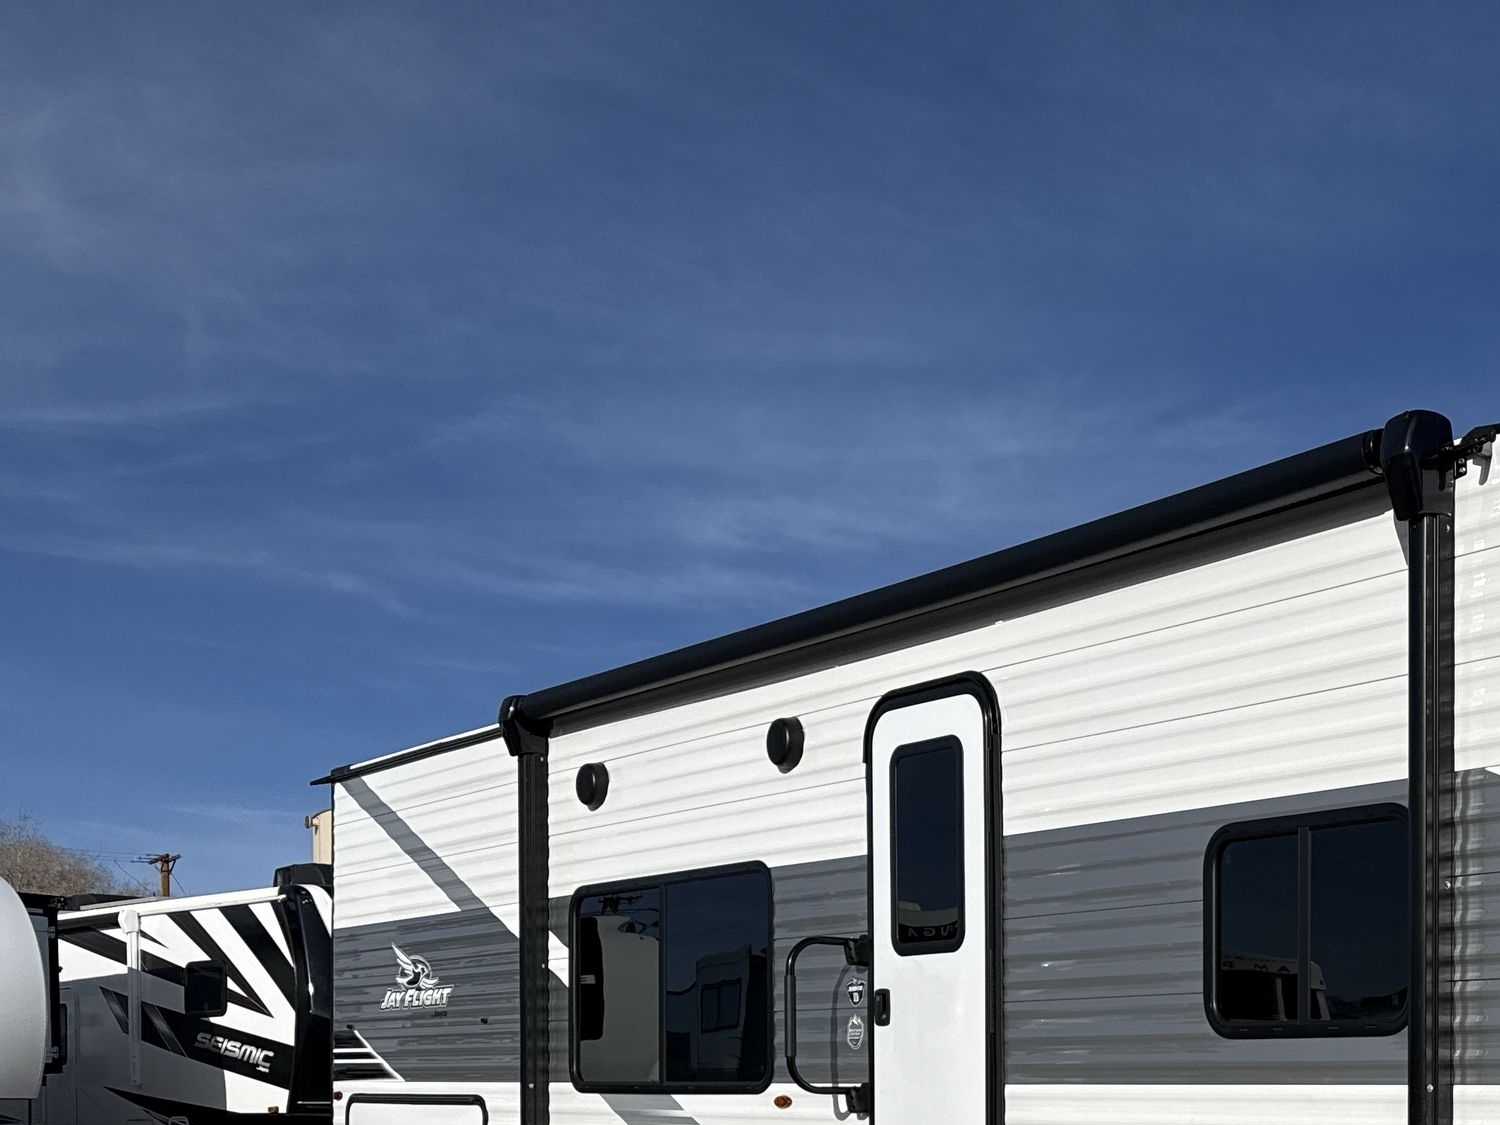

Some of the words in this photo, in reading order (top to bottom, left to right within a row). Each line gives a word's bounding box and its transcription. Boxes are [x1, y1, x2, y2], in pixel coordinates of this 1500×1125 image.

[380, 989, 406, 1009] JAY
[404, 986, 453, 1007] FLIGHT
[194, 1032, 275, 1067] SEISMIC
